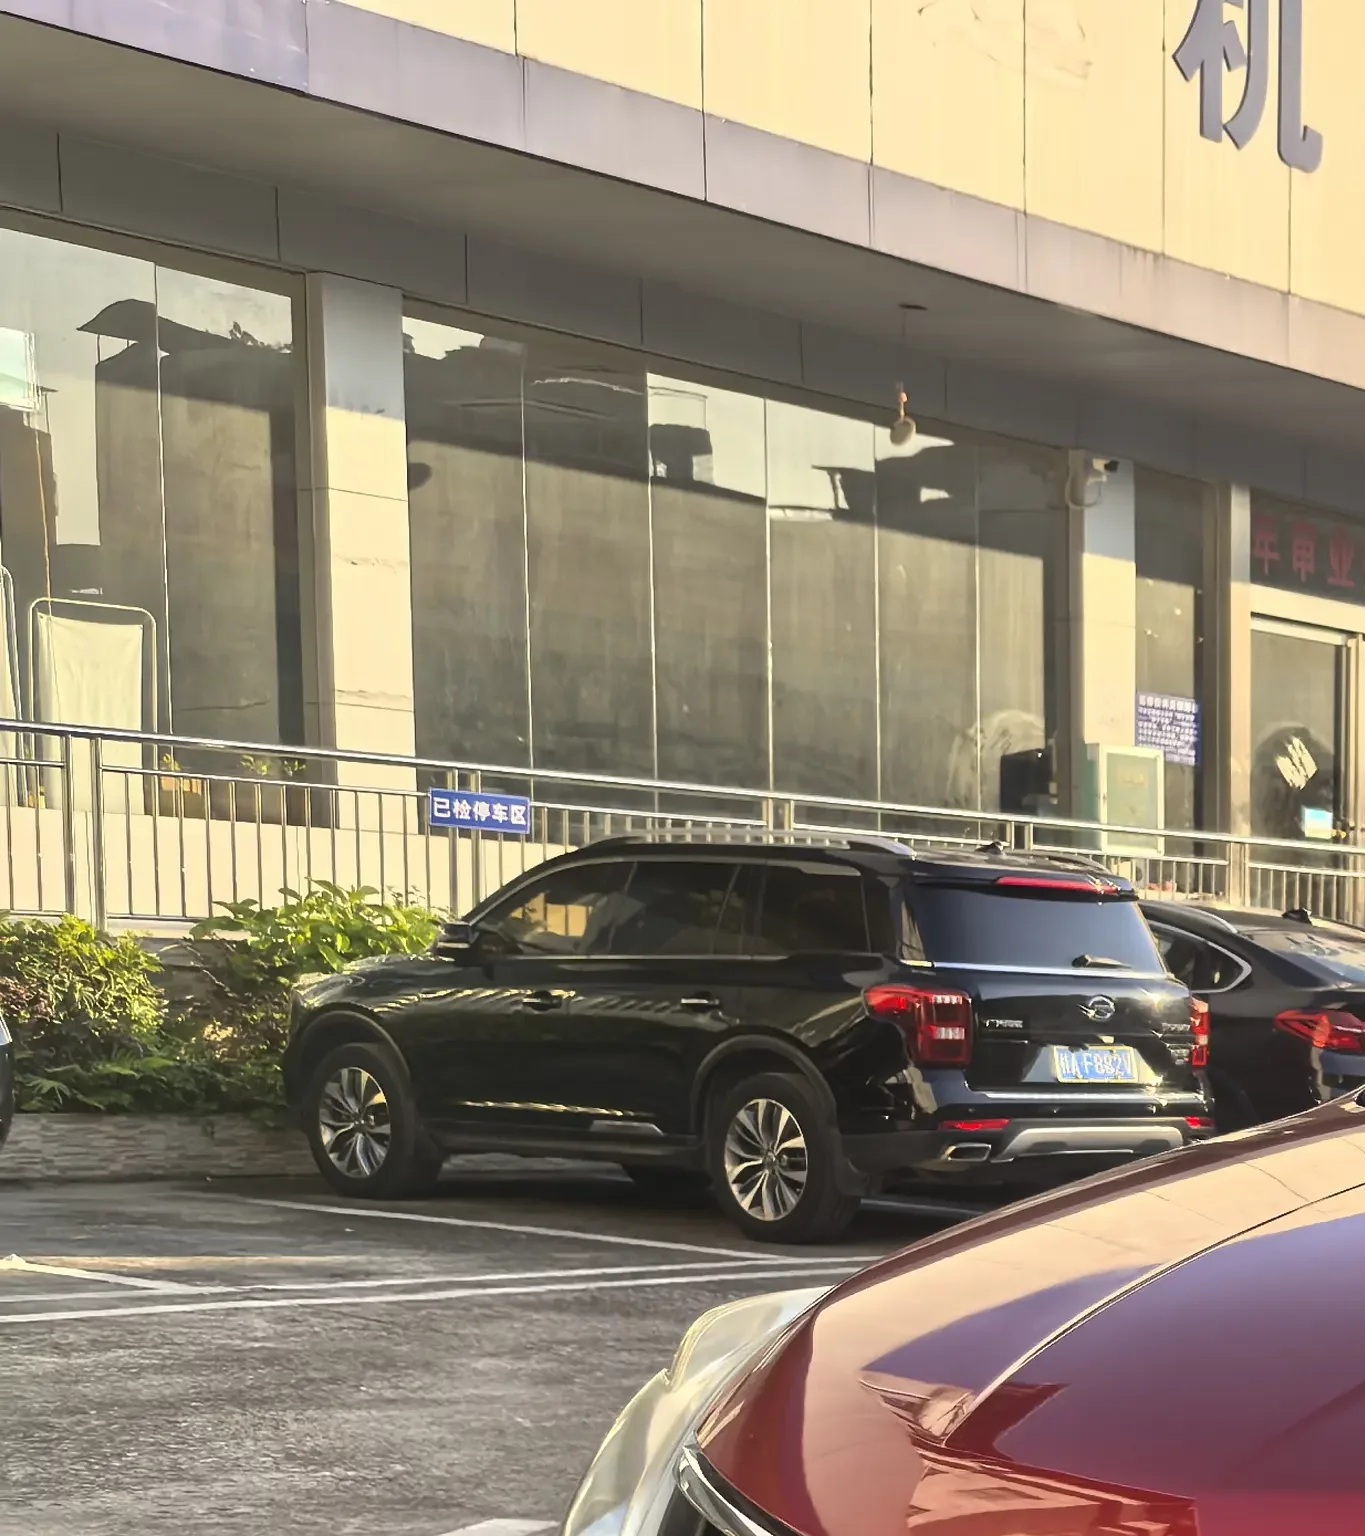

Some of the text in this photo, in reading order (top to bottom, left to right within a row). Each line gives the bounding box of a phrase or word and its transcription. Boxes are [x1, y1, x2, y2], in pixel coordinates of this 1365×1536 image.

[433, 797, 526, 825] 已检停车区
